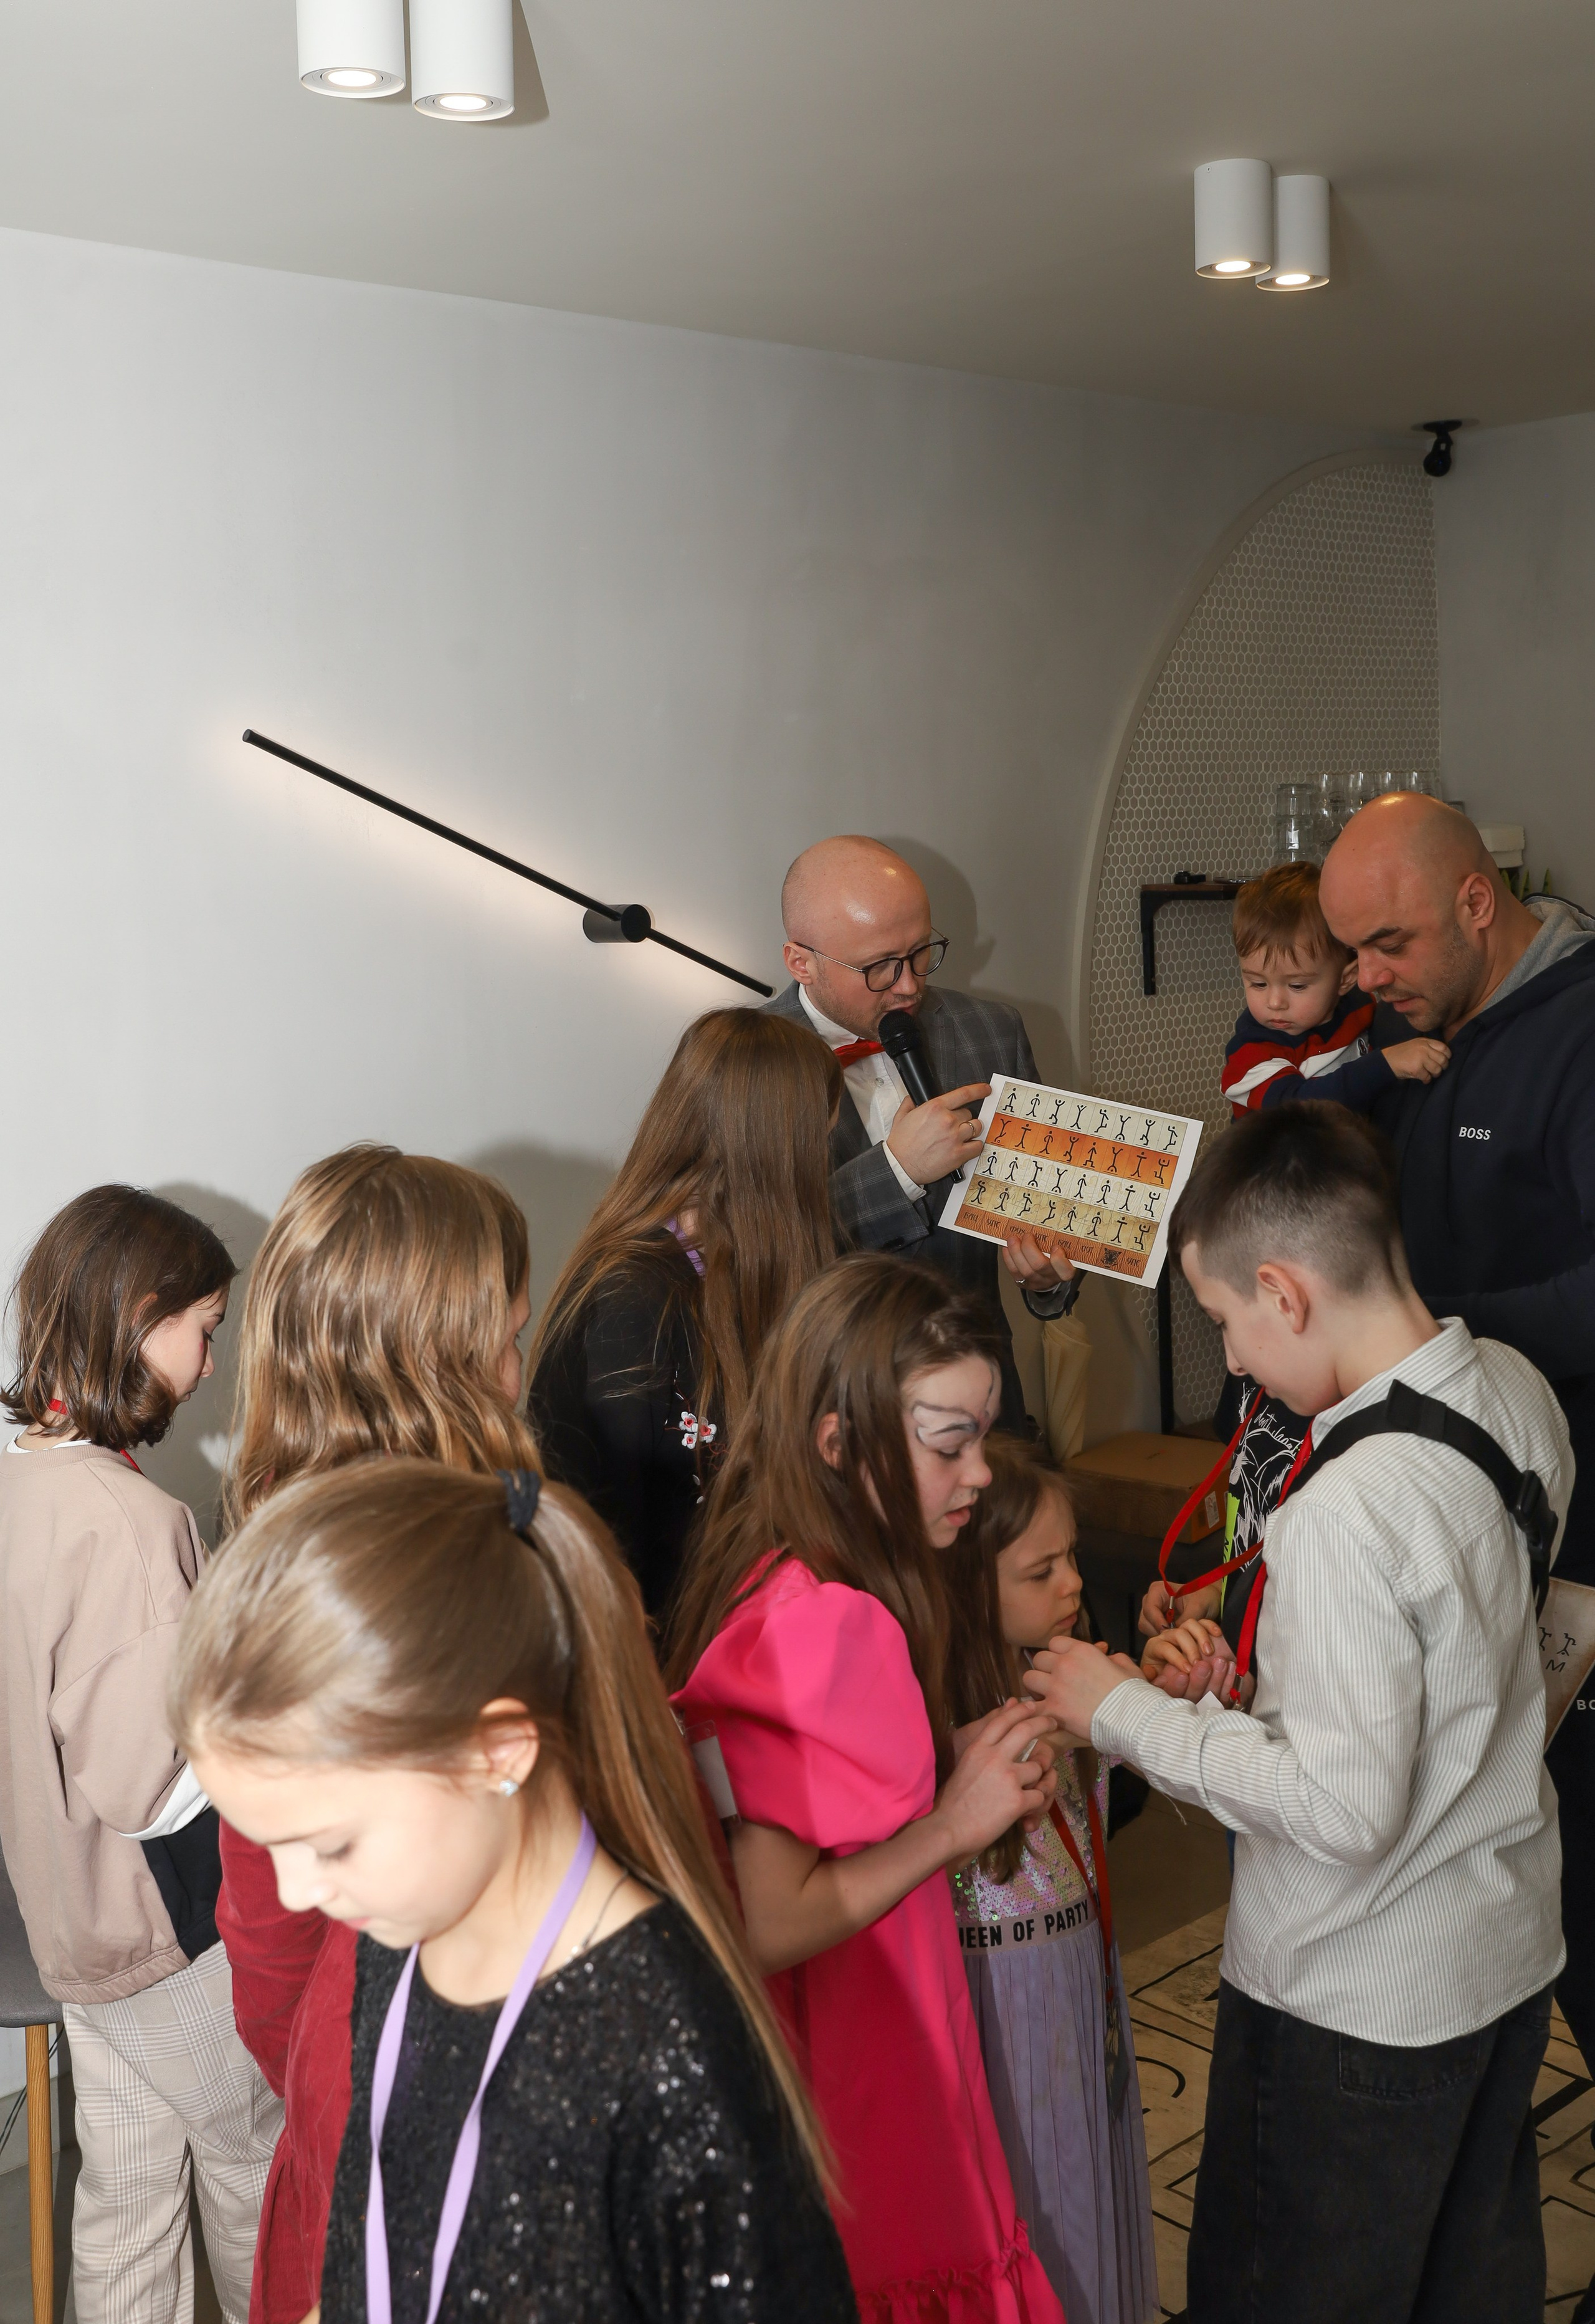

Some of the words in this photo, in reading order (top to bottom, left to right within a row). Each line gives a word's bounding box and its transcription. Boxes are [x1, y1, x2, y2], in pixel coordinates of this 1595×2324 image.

[1459, 1126, 1491, 1140] BOSS
[1012, 1918, 1035, 1943] OF
[1044, 1899, 1089, 1936] PARTY
